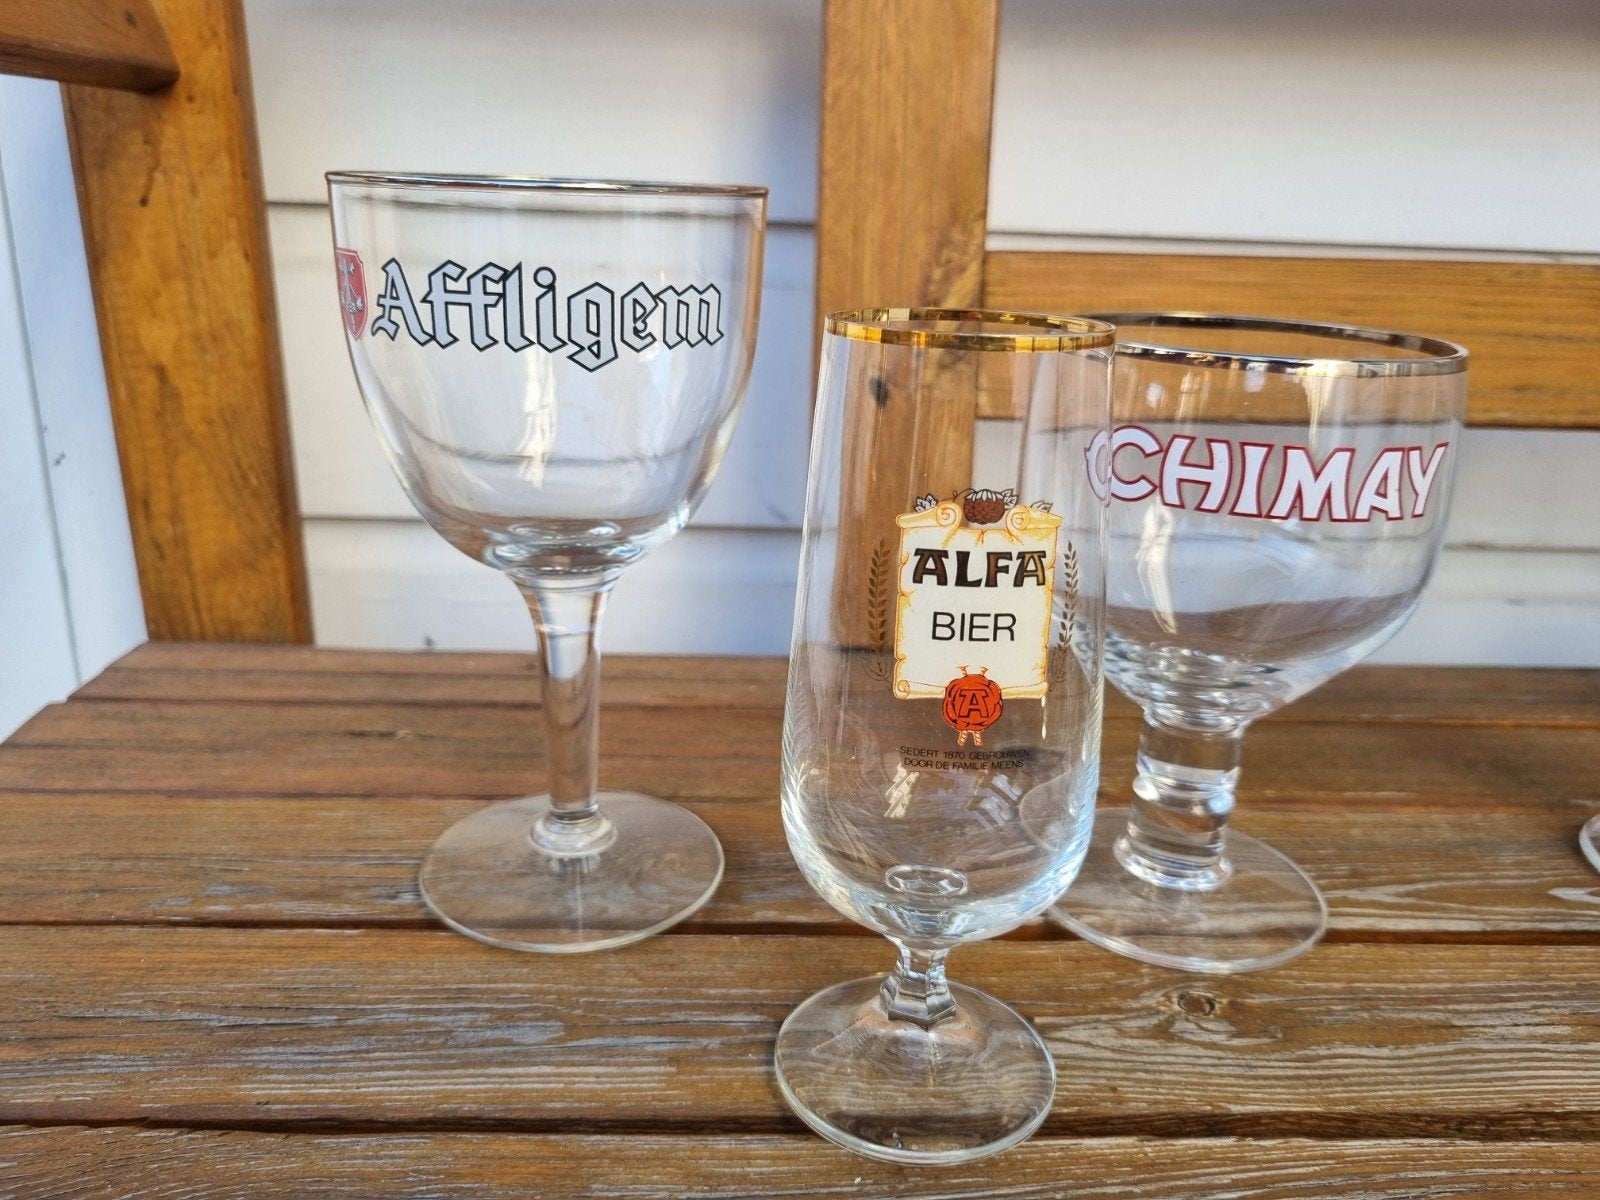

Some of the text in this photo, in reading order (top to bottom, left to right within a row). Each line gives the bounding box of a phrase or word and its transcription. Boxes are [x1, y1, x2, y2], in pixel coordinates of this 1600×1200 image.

[371, 257, 724, 372] Affligem
[1085, 424, 1449, 522] CHIMAY
[912, 547, 1047, 588] ALFA
[931, 611, 1017, 642] BIER
[958, 688, 990, 718] A
[900, 746, 1030, 760] SEDERT 1870 GEBROUWEN
[904, 757, 1024, 770] DOOR DE FAMILIE MEENS
